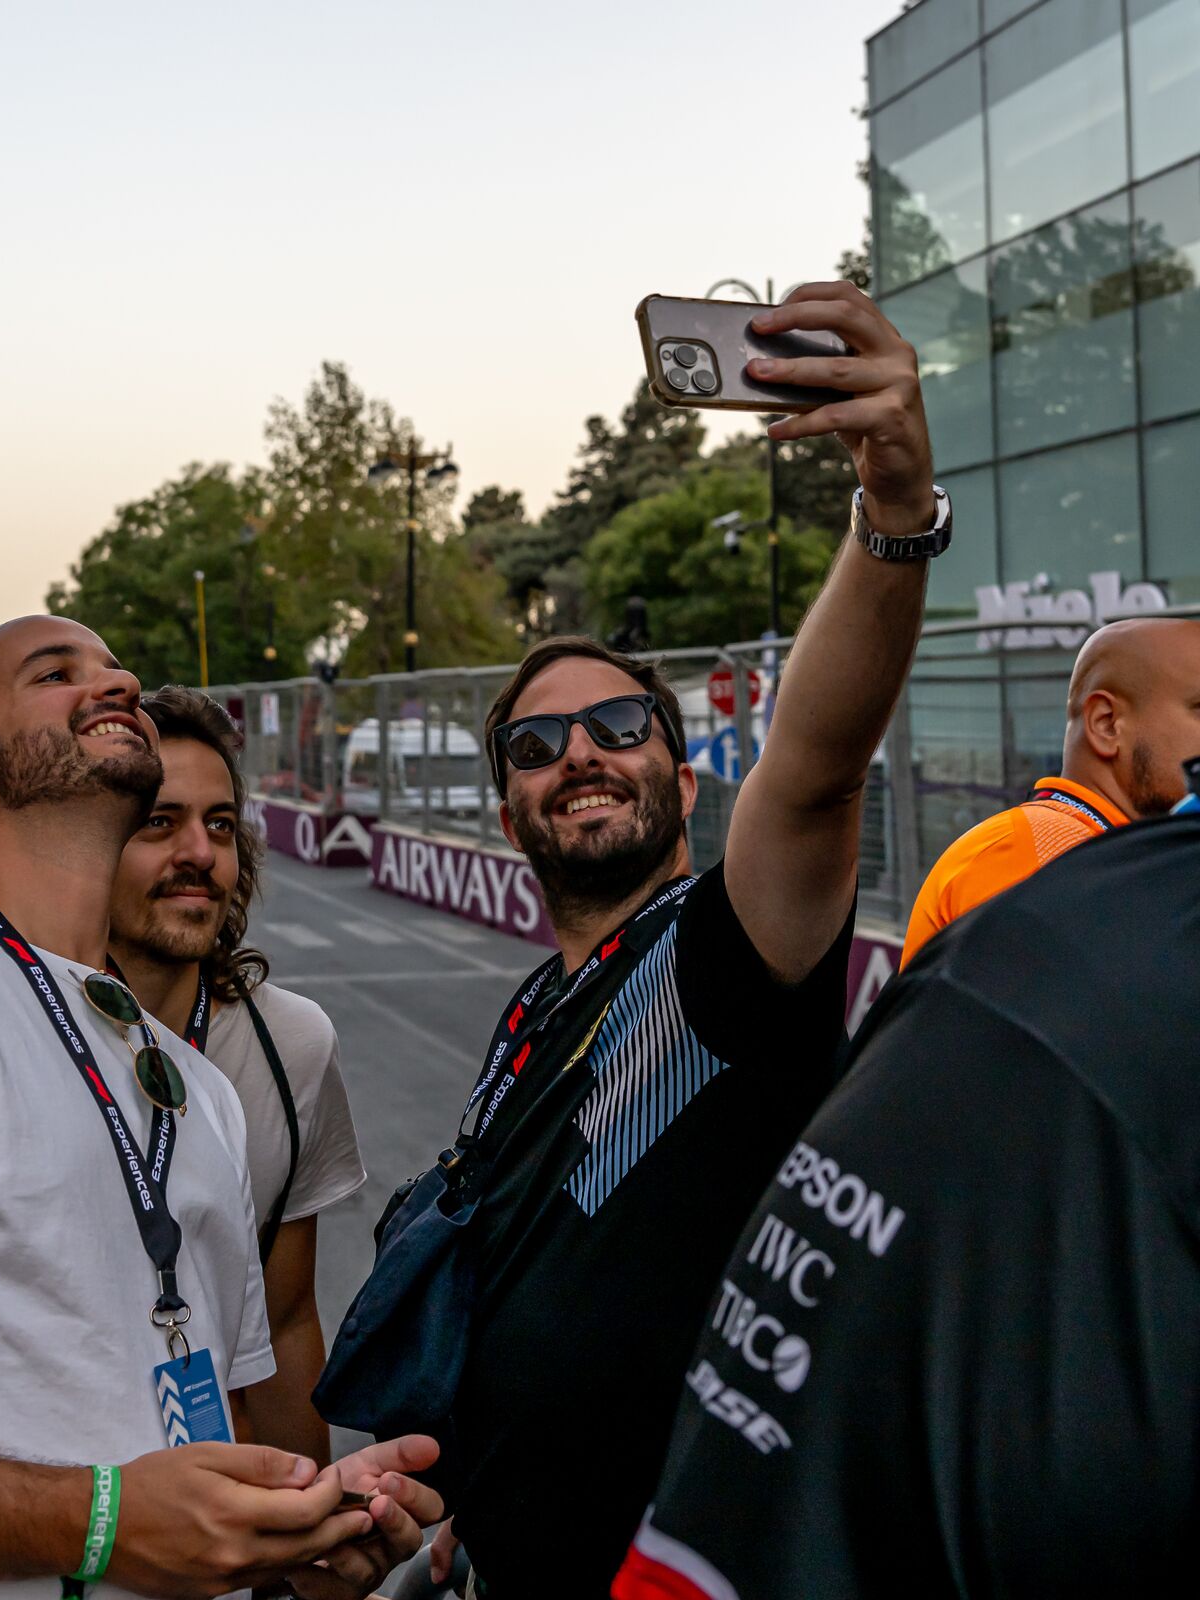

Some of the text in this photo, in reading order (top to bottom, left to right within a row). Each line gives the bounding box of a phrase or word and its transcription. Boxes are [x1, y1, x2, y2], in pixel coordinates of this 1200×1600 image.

[1050, 792, 1108, 831] Experiences
[379, 833, 540, 932] AIRWAYS
[29, 965, 85, 1055] Experiences
[107, 1106, 154, 1211] Experiences
[776, 1141, 906, 1257] EPSON
[746, 1213, 836, 1308] IWC
